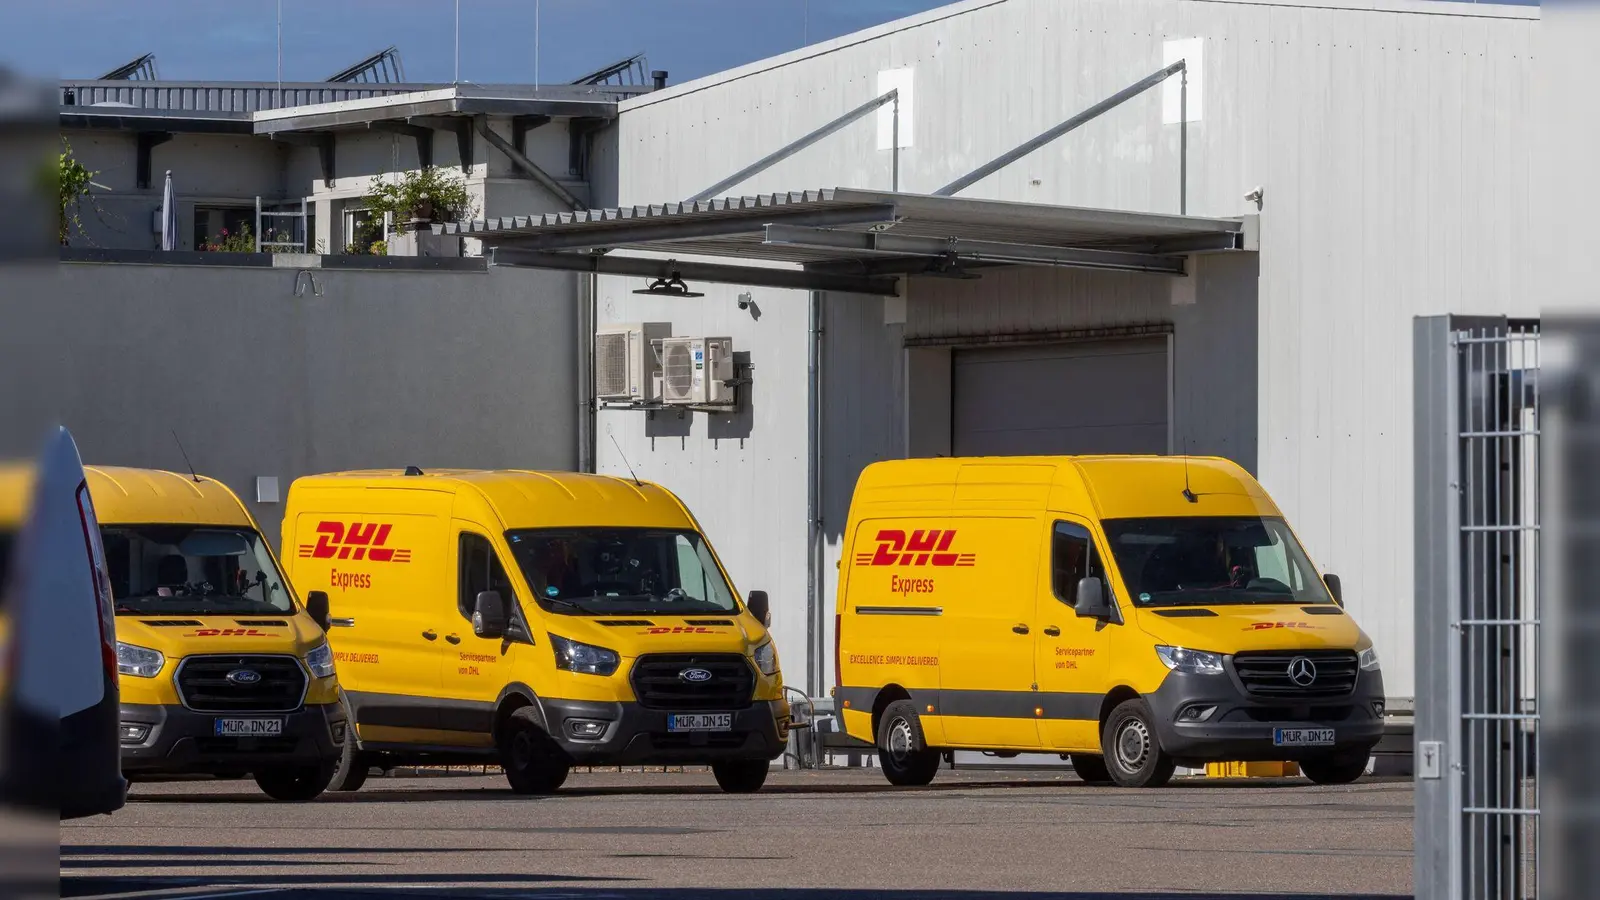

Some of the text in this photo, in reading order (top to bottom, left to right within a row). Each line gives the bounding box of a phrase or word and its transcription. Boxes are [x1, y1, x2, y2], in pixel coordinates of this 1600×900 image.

[312, 520, 395, 562] DHL
[871, 529, 959, 567] DHL
[331, 568, 371, 591] Express
[891, 575, 934, 597] Express
[647, 626, 714, 635] DHL
[1251, 621, 1316, 630] DHL
[194, 628, 268, 637] DHL
[350, 652, 380, 664] DELIVERED.
[459, 651, 497, 663] Servicepartner
[1055, 646, 1095, 658] Servicepartner
[886, 655, 906, 665] SIMPLY
[906, 656, 940, 666] DELIVERED.
[1055, 660, 1077, 669] von DHL
[239, 671, 255, 682] Ford
[458, 666, 480, 676] von DHL
[689, 670, 708, 680] Ford
[223, 720, 244, 733] MÜR
[675, 715, 695, 728] MÜR
[1282, 730, 1302, 742] MÜR
